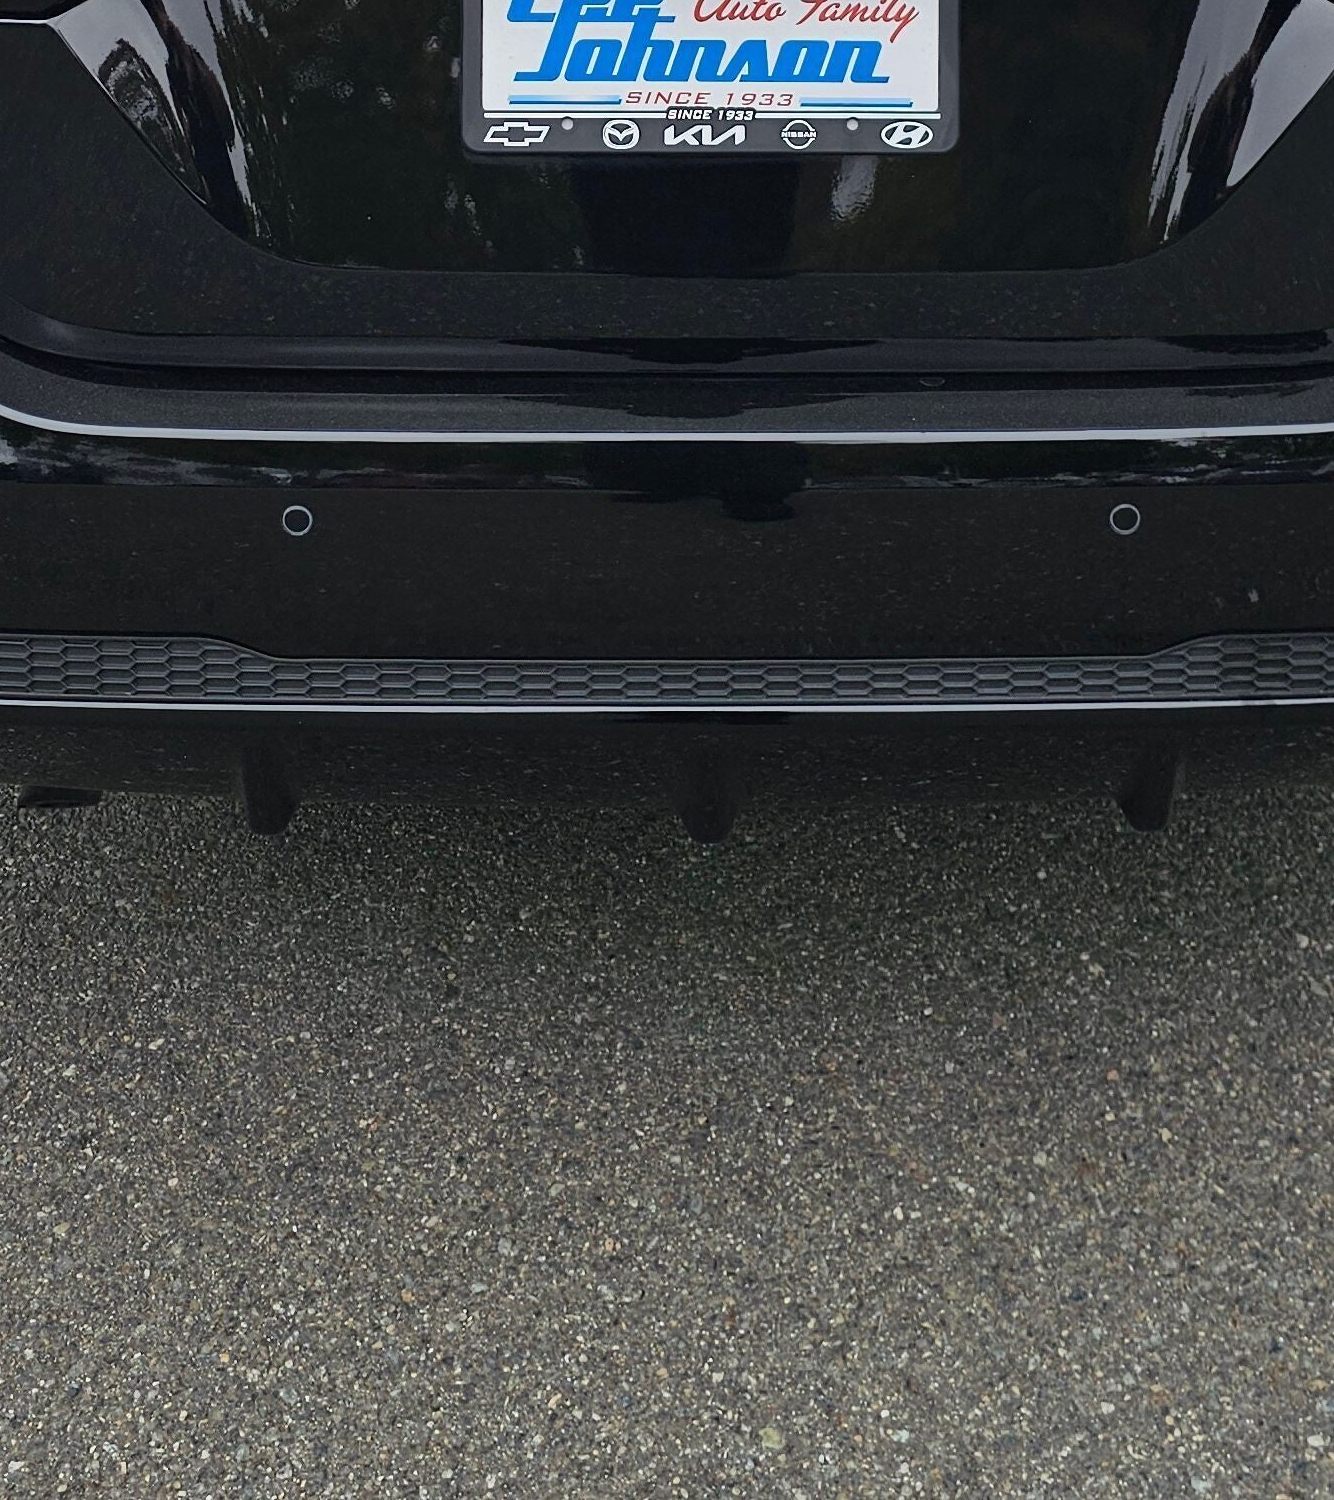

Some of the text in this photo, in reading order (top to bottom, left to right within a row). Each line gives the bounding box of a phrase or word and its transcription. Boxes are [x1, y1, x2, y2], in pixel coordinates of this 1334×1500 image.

[513, 15, 890, 83] Johnson
[625, 91, 794, 107] SINCE 1933
[668, 109, 754, 121] SINCE 1933
